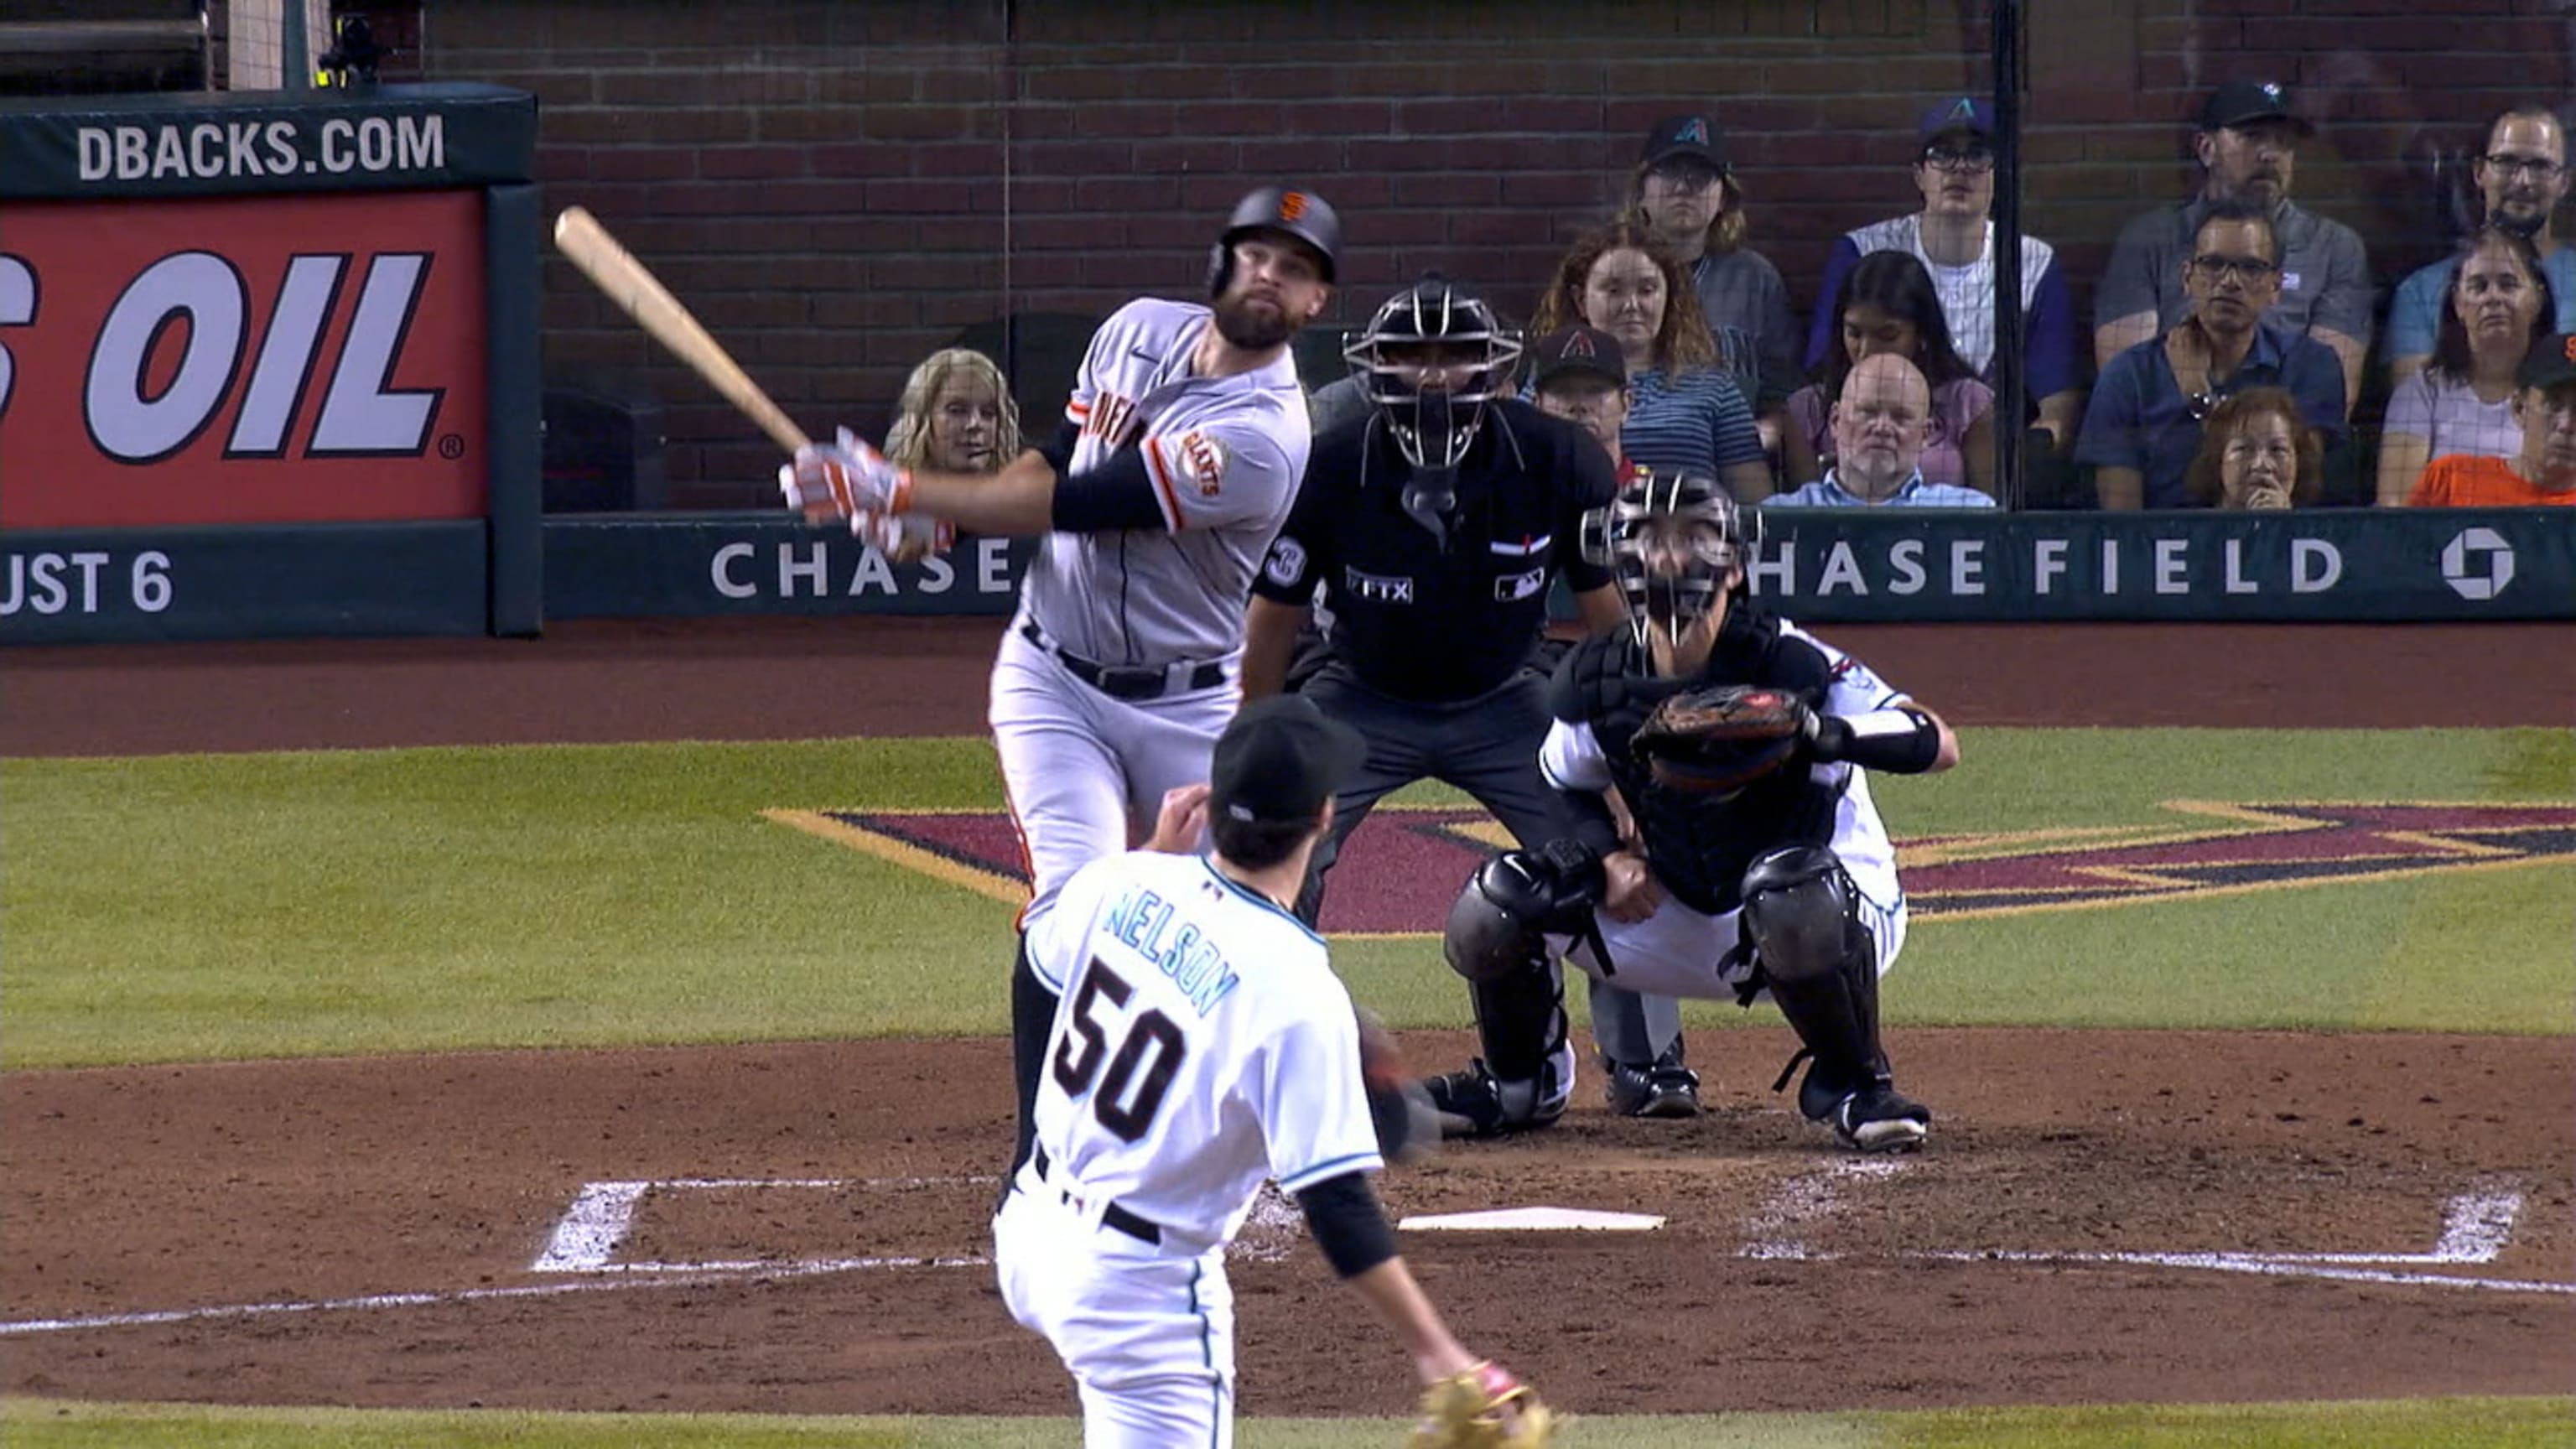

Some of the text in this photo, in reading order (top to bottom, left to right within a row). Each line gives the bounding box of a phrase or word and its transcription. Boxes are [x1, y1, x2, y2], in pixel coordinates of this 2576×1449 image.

[78, 115, 445, 181] DBACKS.COM
[83, 250, 446, 466] OIL
[1183, 430, 1220, 496] GIANTS
[132, 550, 173, 613] 6
[710, 538, 1011, 599] CHASE
[1265, 535, 1309, 587] 3
[1747, 538, 2344, 597] HASE FIELD
[1103, 889, 1240, 1019] NELSON
[1053, 953, 1188, 1145] 50
